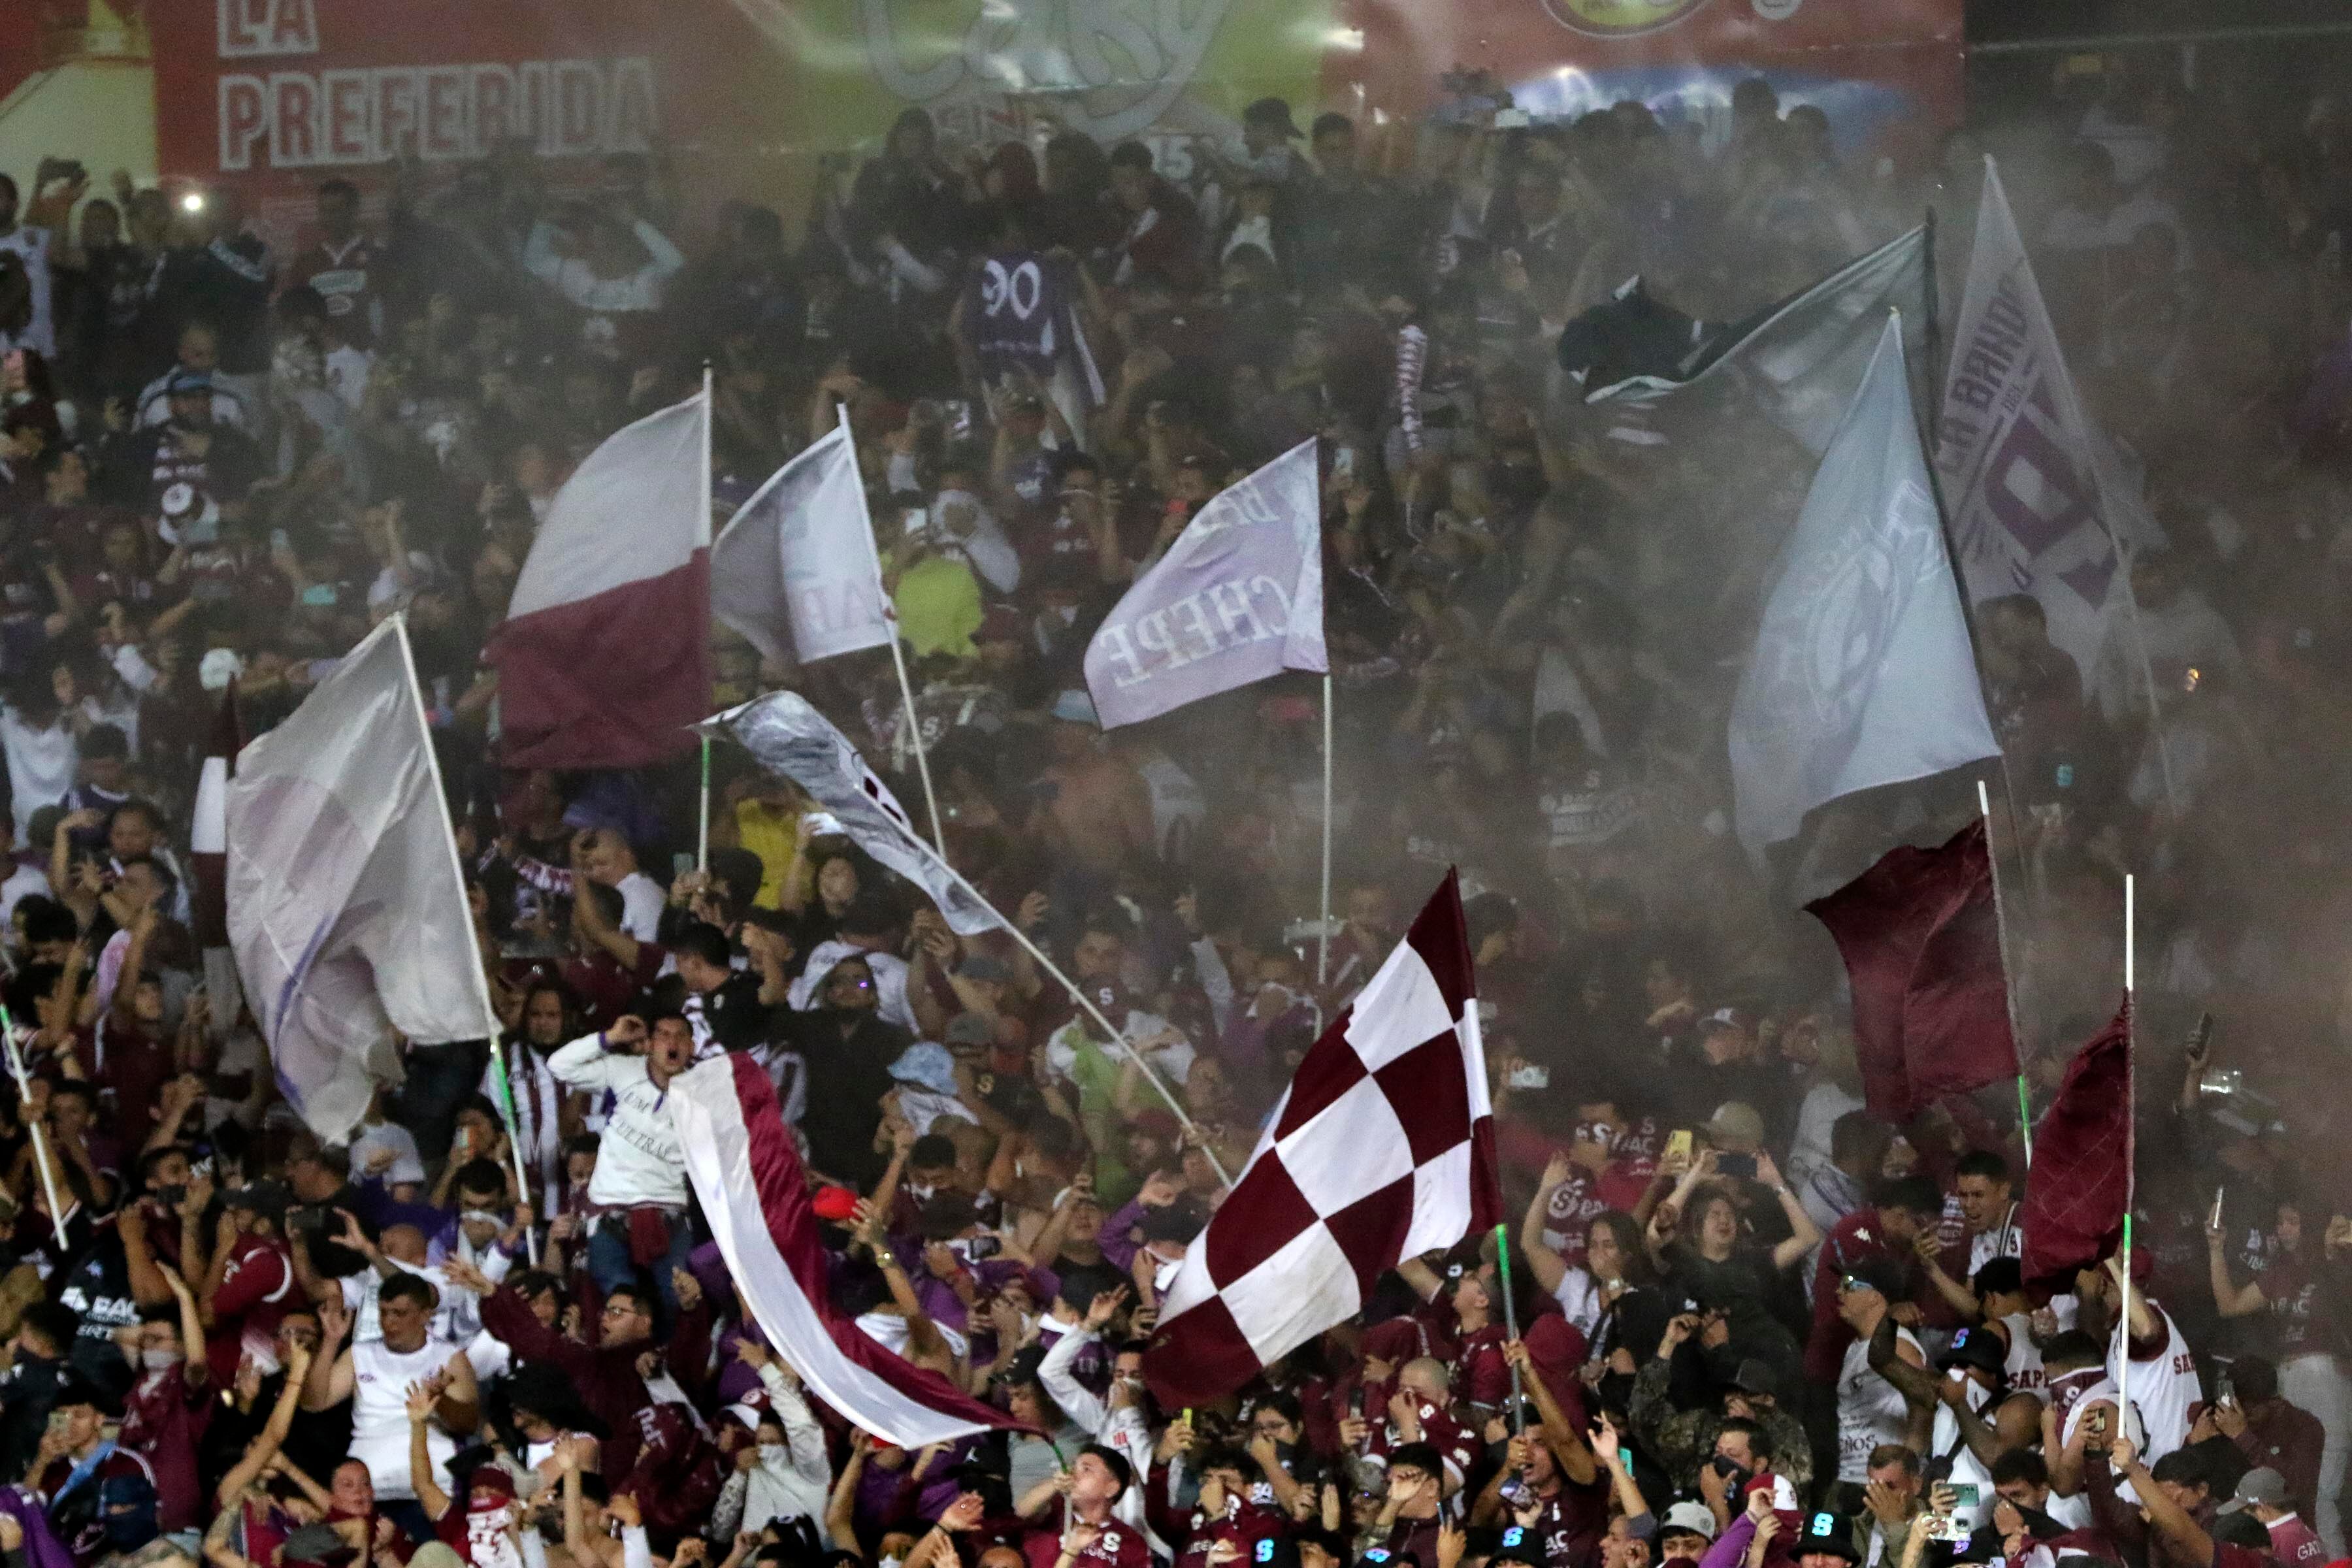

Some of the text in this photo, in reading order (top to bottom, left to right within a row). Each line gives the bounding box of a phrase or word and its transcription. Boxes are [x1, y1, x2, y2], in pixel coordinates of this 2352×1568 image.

[218, 0, 320, 59] LA
[218, 56, 652, 171] PREFERIDA
[981, 259, 1041, 320] 90
[1502, 1526, 1524, 1548] S
[1812, 1512, 1835, 1537] S
[1102, 1532, 1122, 1553] S
[1255, 1538, 1274, 1563] S
